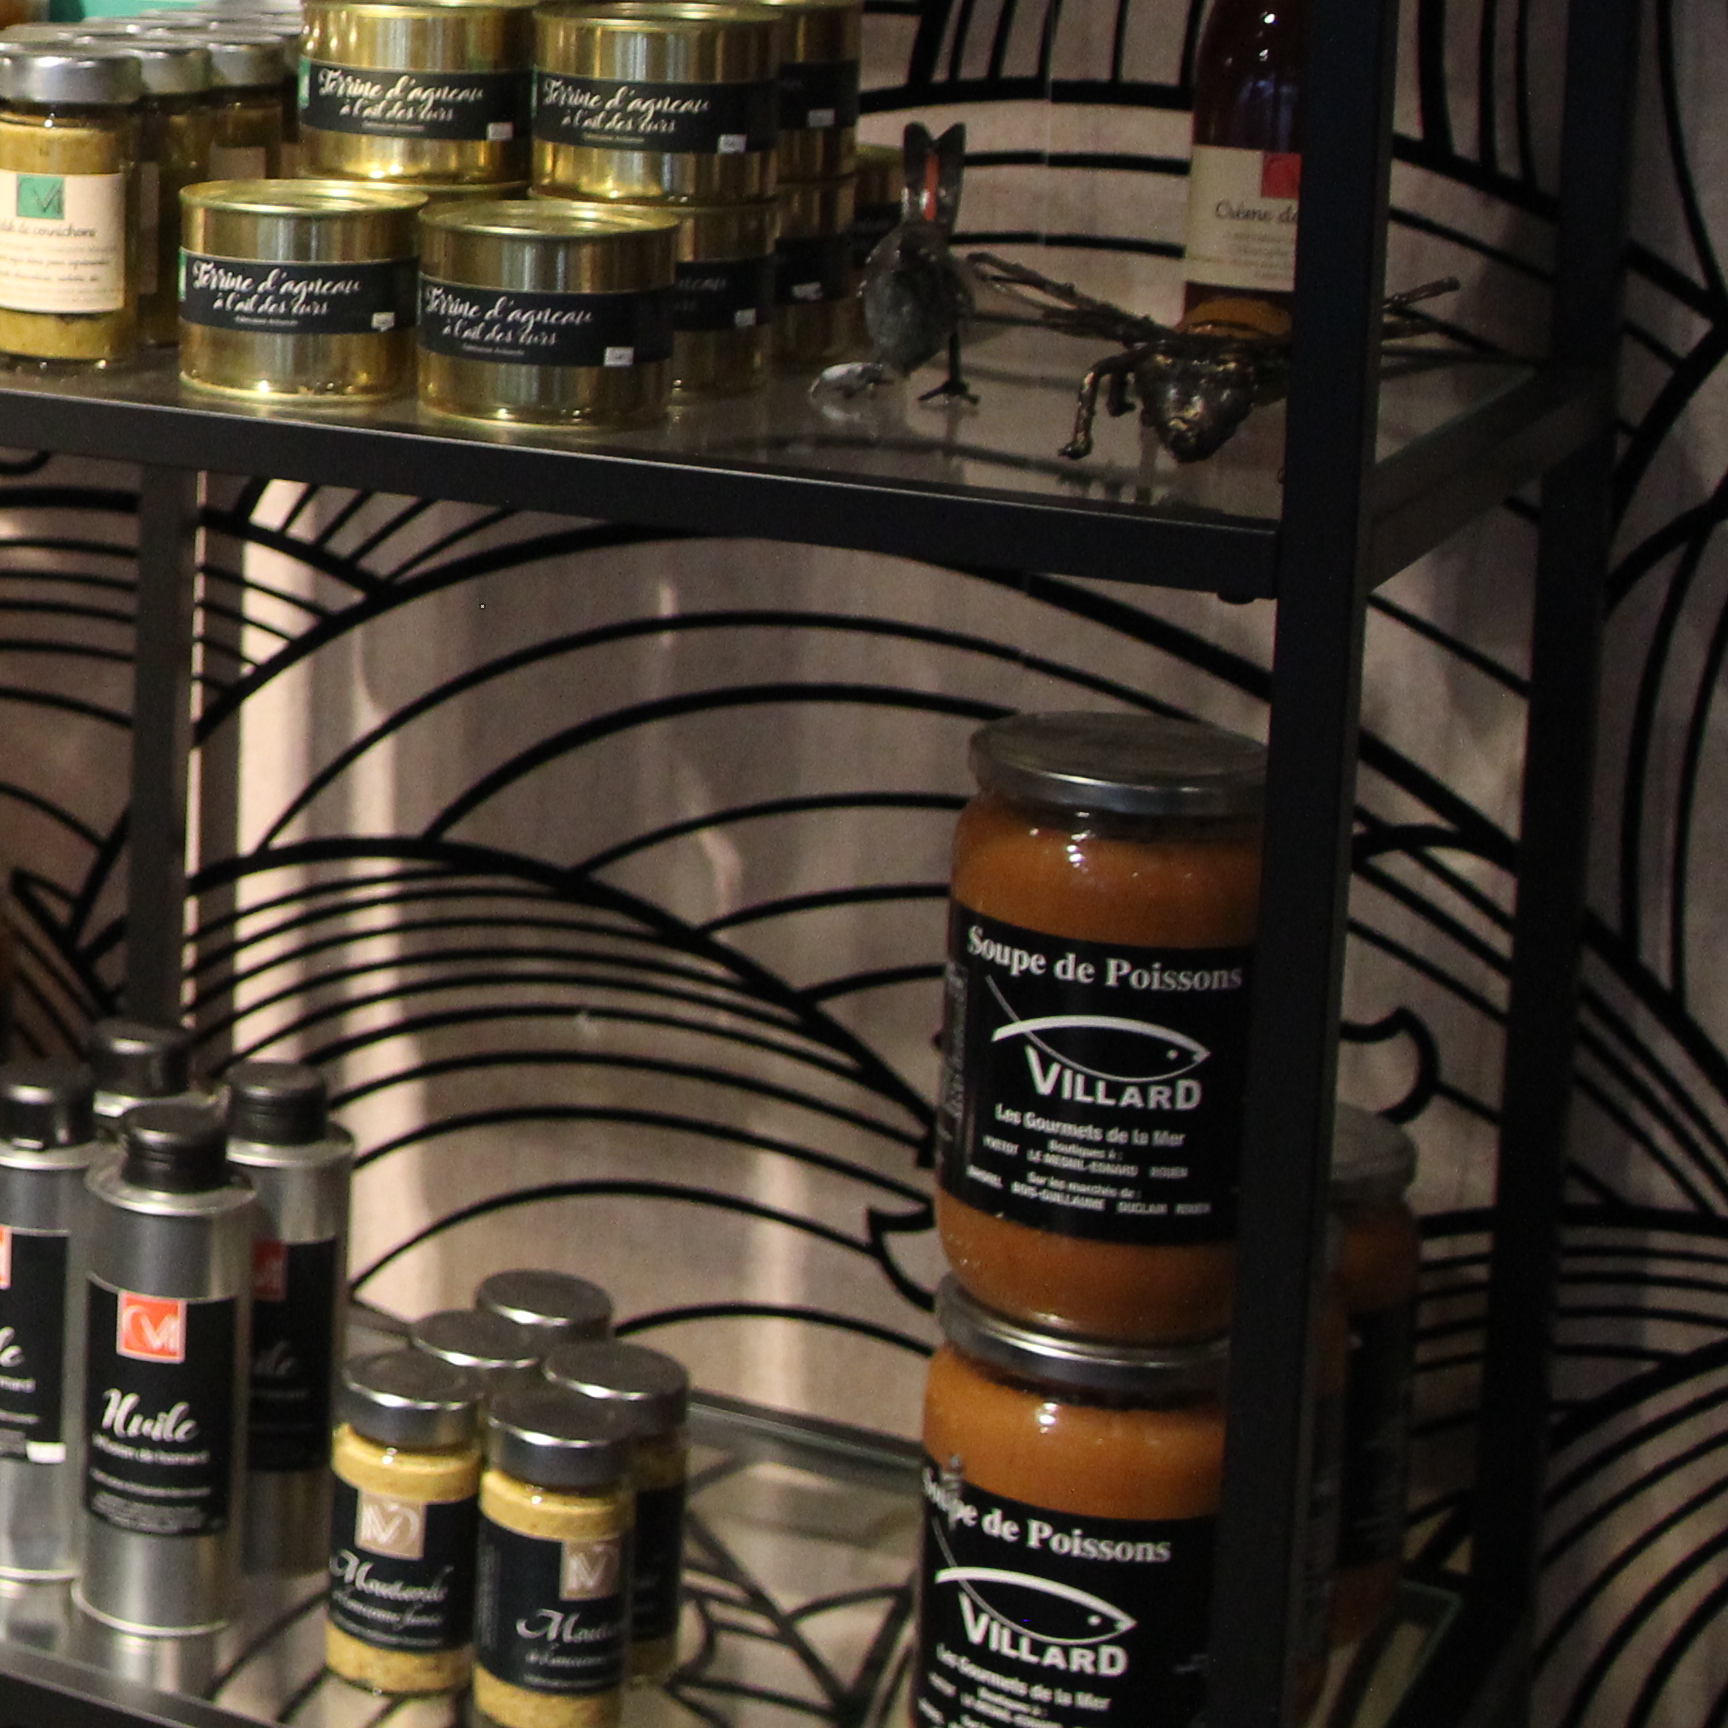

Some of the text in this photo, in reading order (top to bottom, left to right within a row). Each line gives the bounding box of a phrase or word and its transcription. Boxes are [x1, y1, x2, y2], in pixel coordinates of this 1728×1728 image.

[318, 69, 485, 109] Terrine d'agneau
[545, 78, 711, 120] Terrine d'agneau
[385, 100, 416, 122] des
[605, 112, 634, 132] des
[192, 259, 363, 303] Terrine d'agneau
[257, 293, 287, 315] des
[425, 285, 594, 332] Terrine d'agneau
[484, 322, 514, 344] des
[966, 924, 1243, 992] Soupe de Poissons
[1024, 1044, 1203, 1111] VILLARD
[994, 1102, 1186, 1147] Les Gourmets de la Mer
[1026, 1171, 1046, 1186] Sur
[101, 1387, 200, 1443] Huile
[981, 1508, 1173, 1564] de Poissons
[959, 1591, 1131, 1678] VILLARD
[1029, 1683, 1053, 1704] de
[1054, 1687, 1073, 1708] la
[1074, 1691, 1113, 1712] Mer
